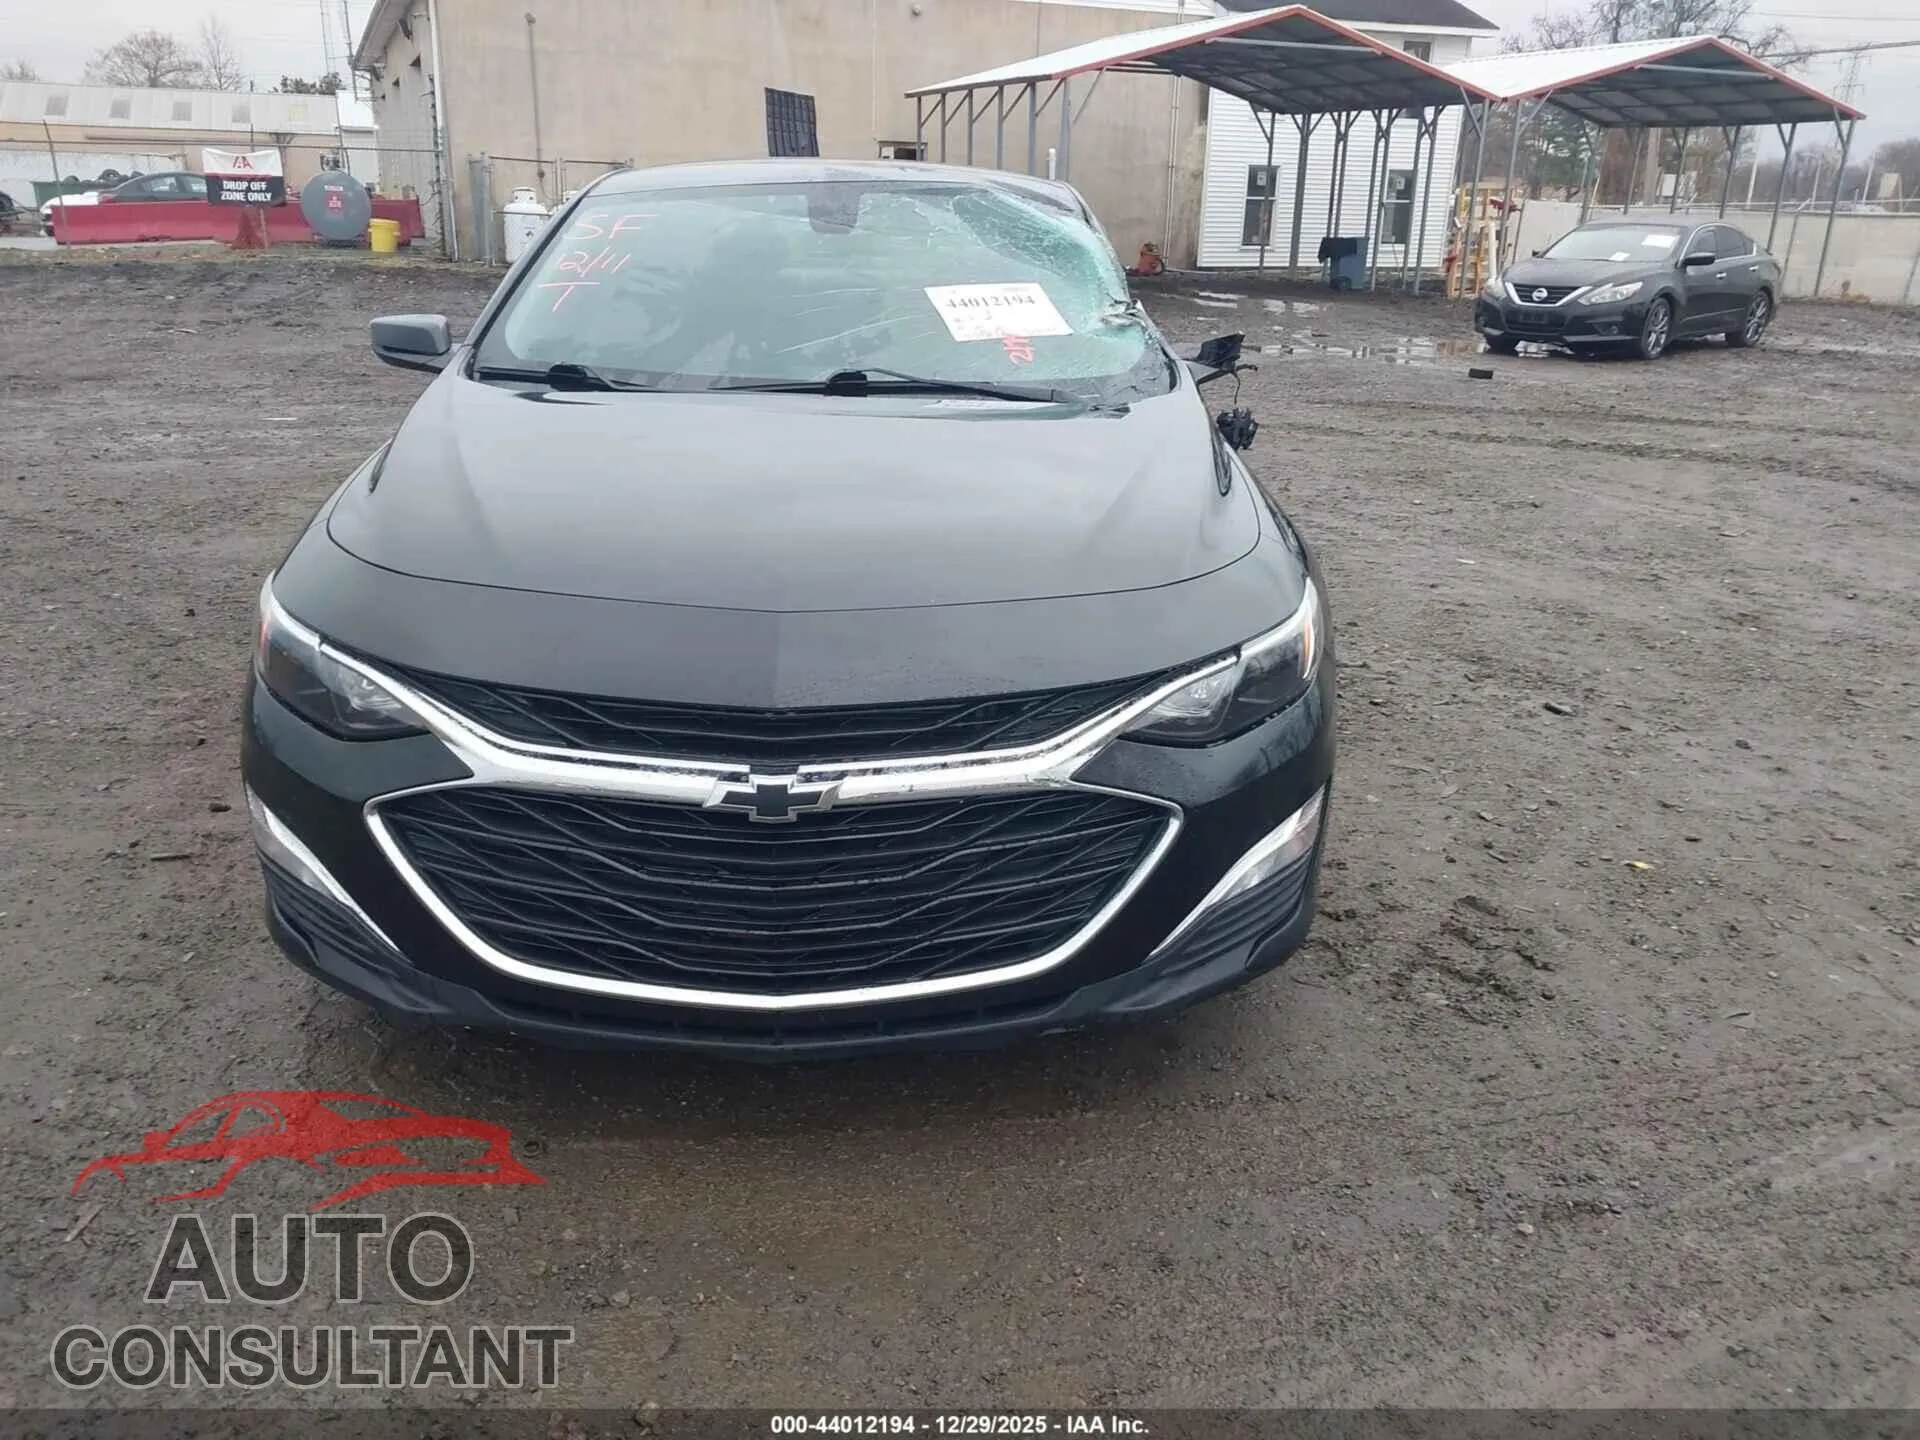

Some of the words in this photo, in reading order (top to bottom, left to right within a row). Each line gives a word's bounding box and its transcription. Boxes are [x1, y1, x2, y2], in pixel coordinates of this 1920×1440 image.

[223, 180, 249, 191] DROP
[250, 181, 268, 192] OFF
[220, 191, 247, 201] ZONE
[247, 193, 272, 203] ONLY
[563, 213, 659, 240] SF
[536, 281, 601, 313] T
[946, 295, 1035, 310] 44012194
